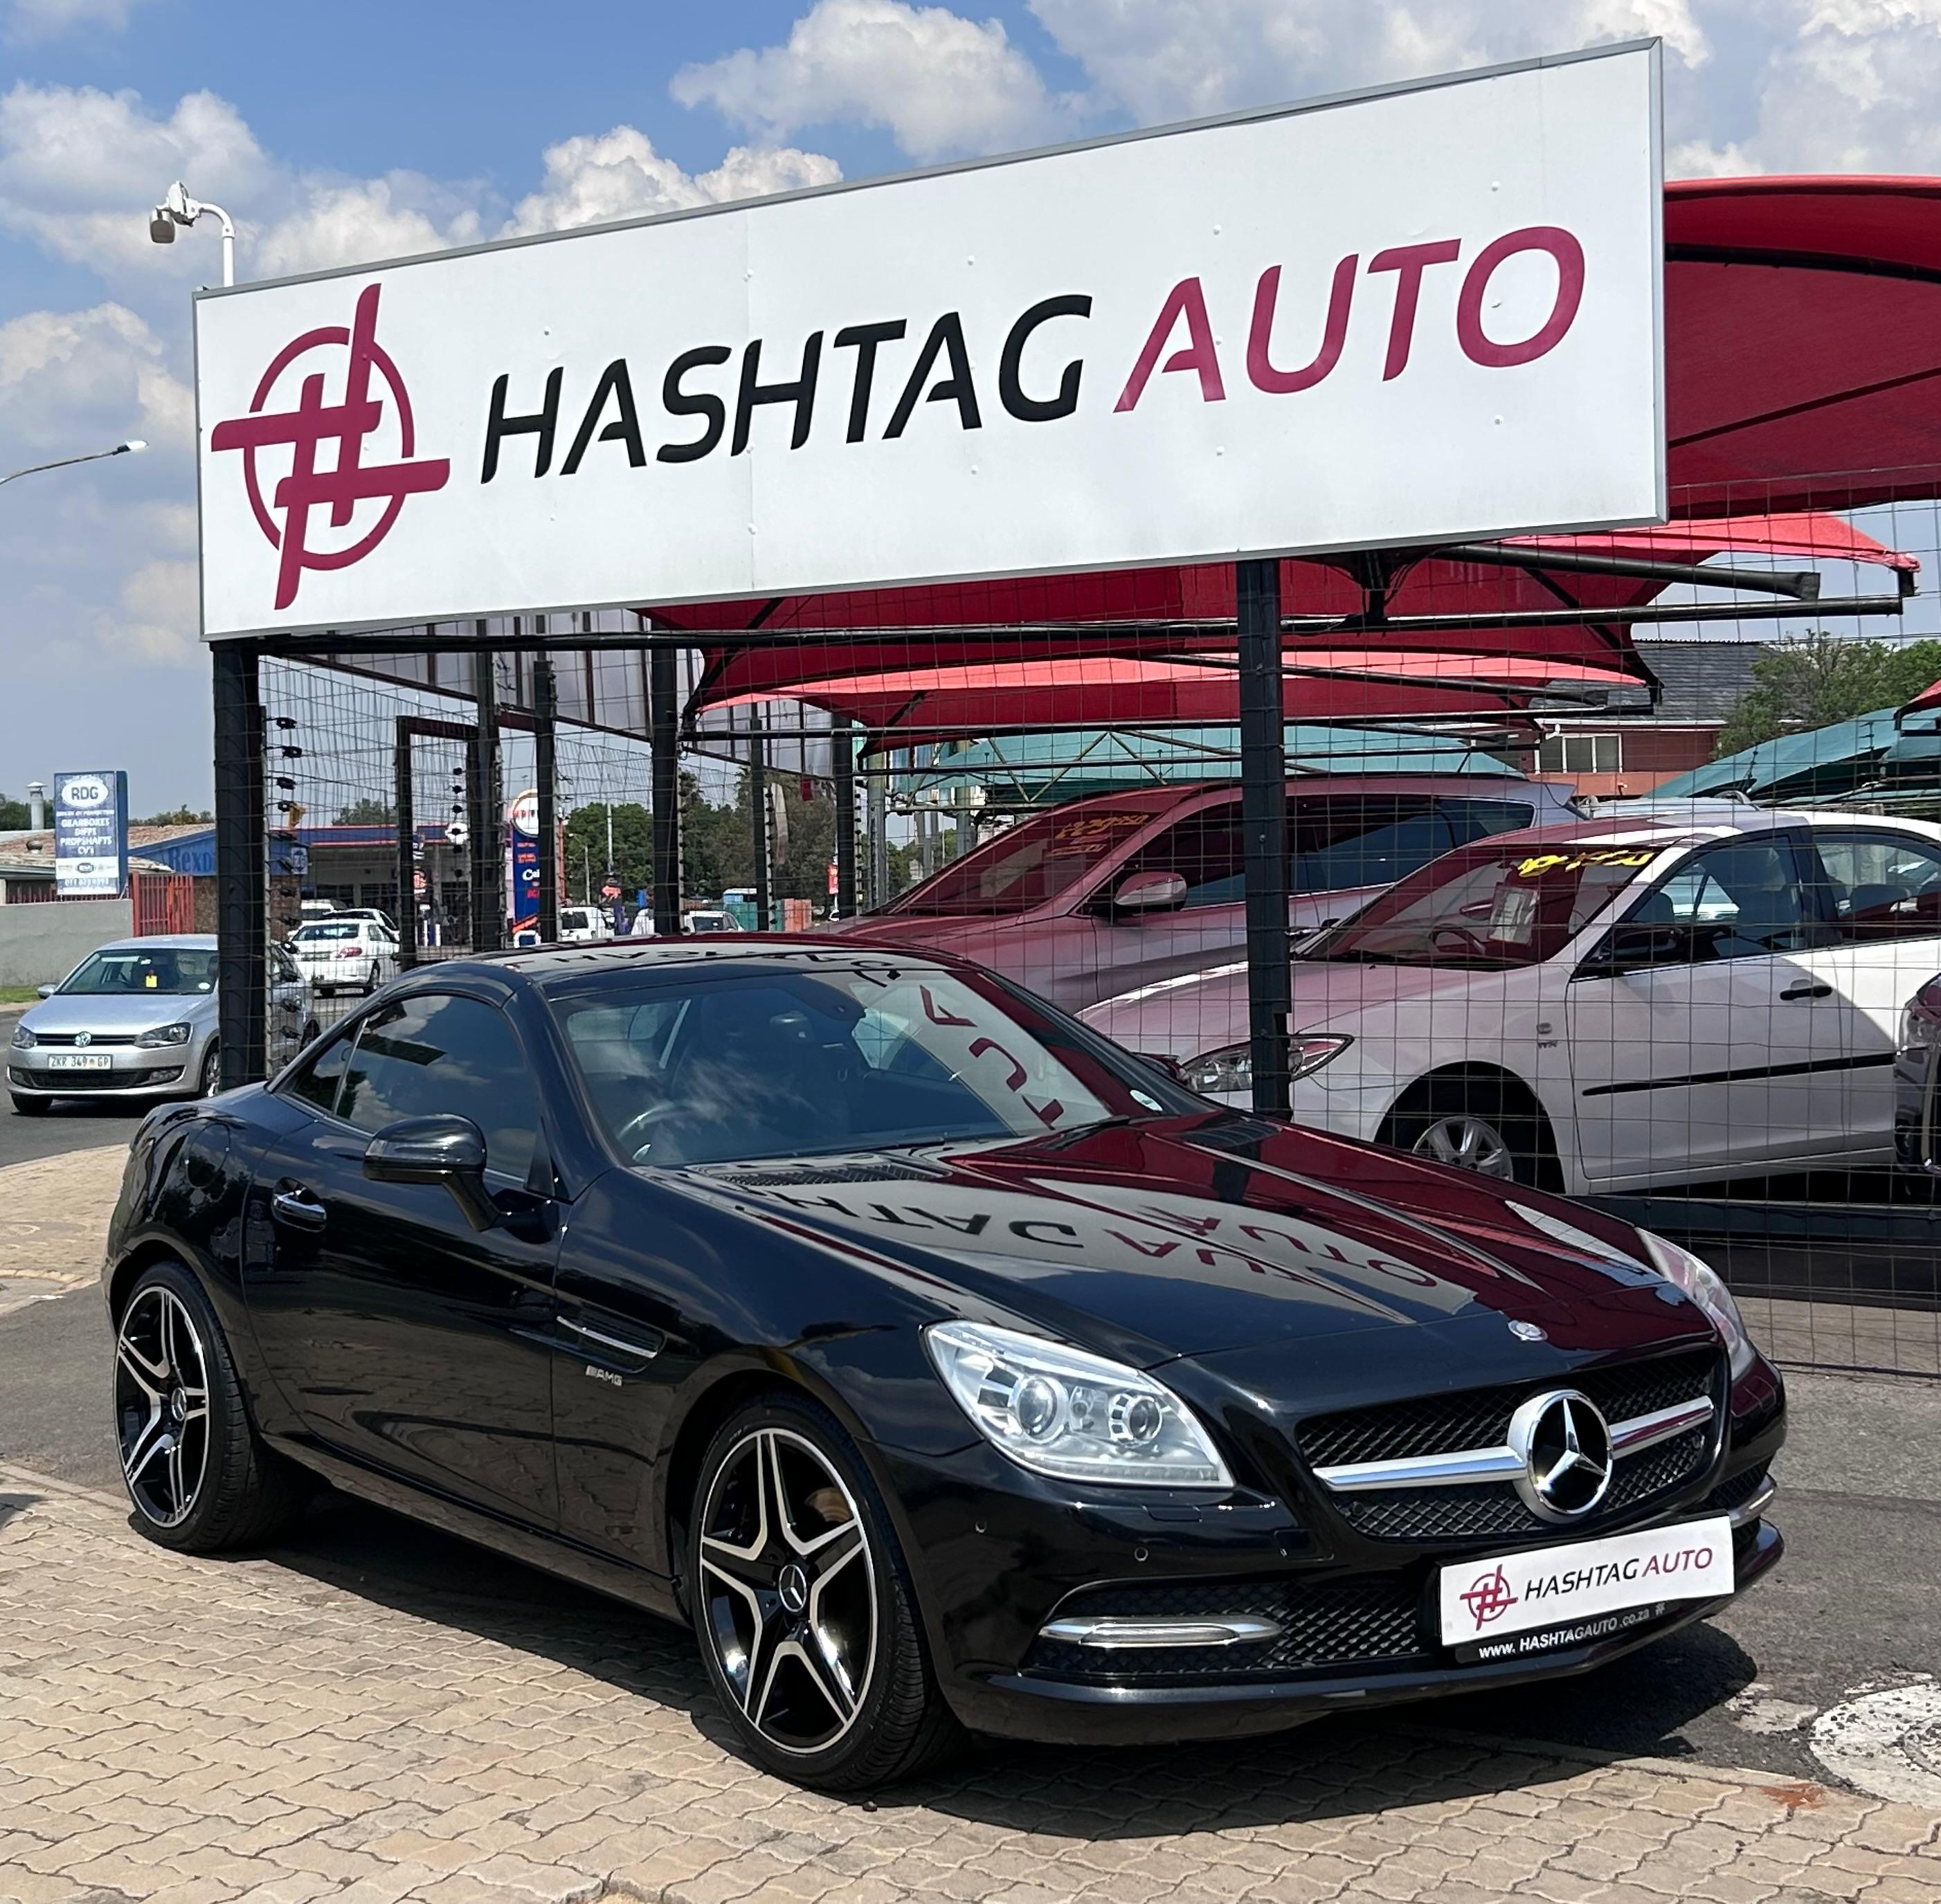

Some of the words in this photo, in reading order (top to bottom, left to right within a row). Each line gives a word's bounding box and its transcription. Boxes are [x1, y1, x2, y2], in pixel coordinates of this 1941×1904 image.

[480, 294, 1093, 484] HASHTAG
[1114, 226, 1585, 412] AUTO
[71, 786, 98, 800] RDG
[61, 817, 109, 828] GEARBOXES
[98, 1056, 109, 1067] GP
[596, 1368, 623, 1386] AMG
[1524, 1558, 1639, 1602] HASHTAG
[1641, 1547, 1713, 1578] AUTO
[1479, 1643, 1516, 1659] www.
[1519, 1617, 1618, 1652] HASHTAGAUTO
